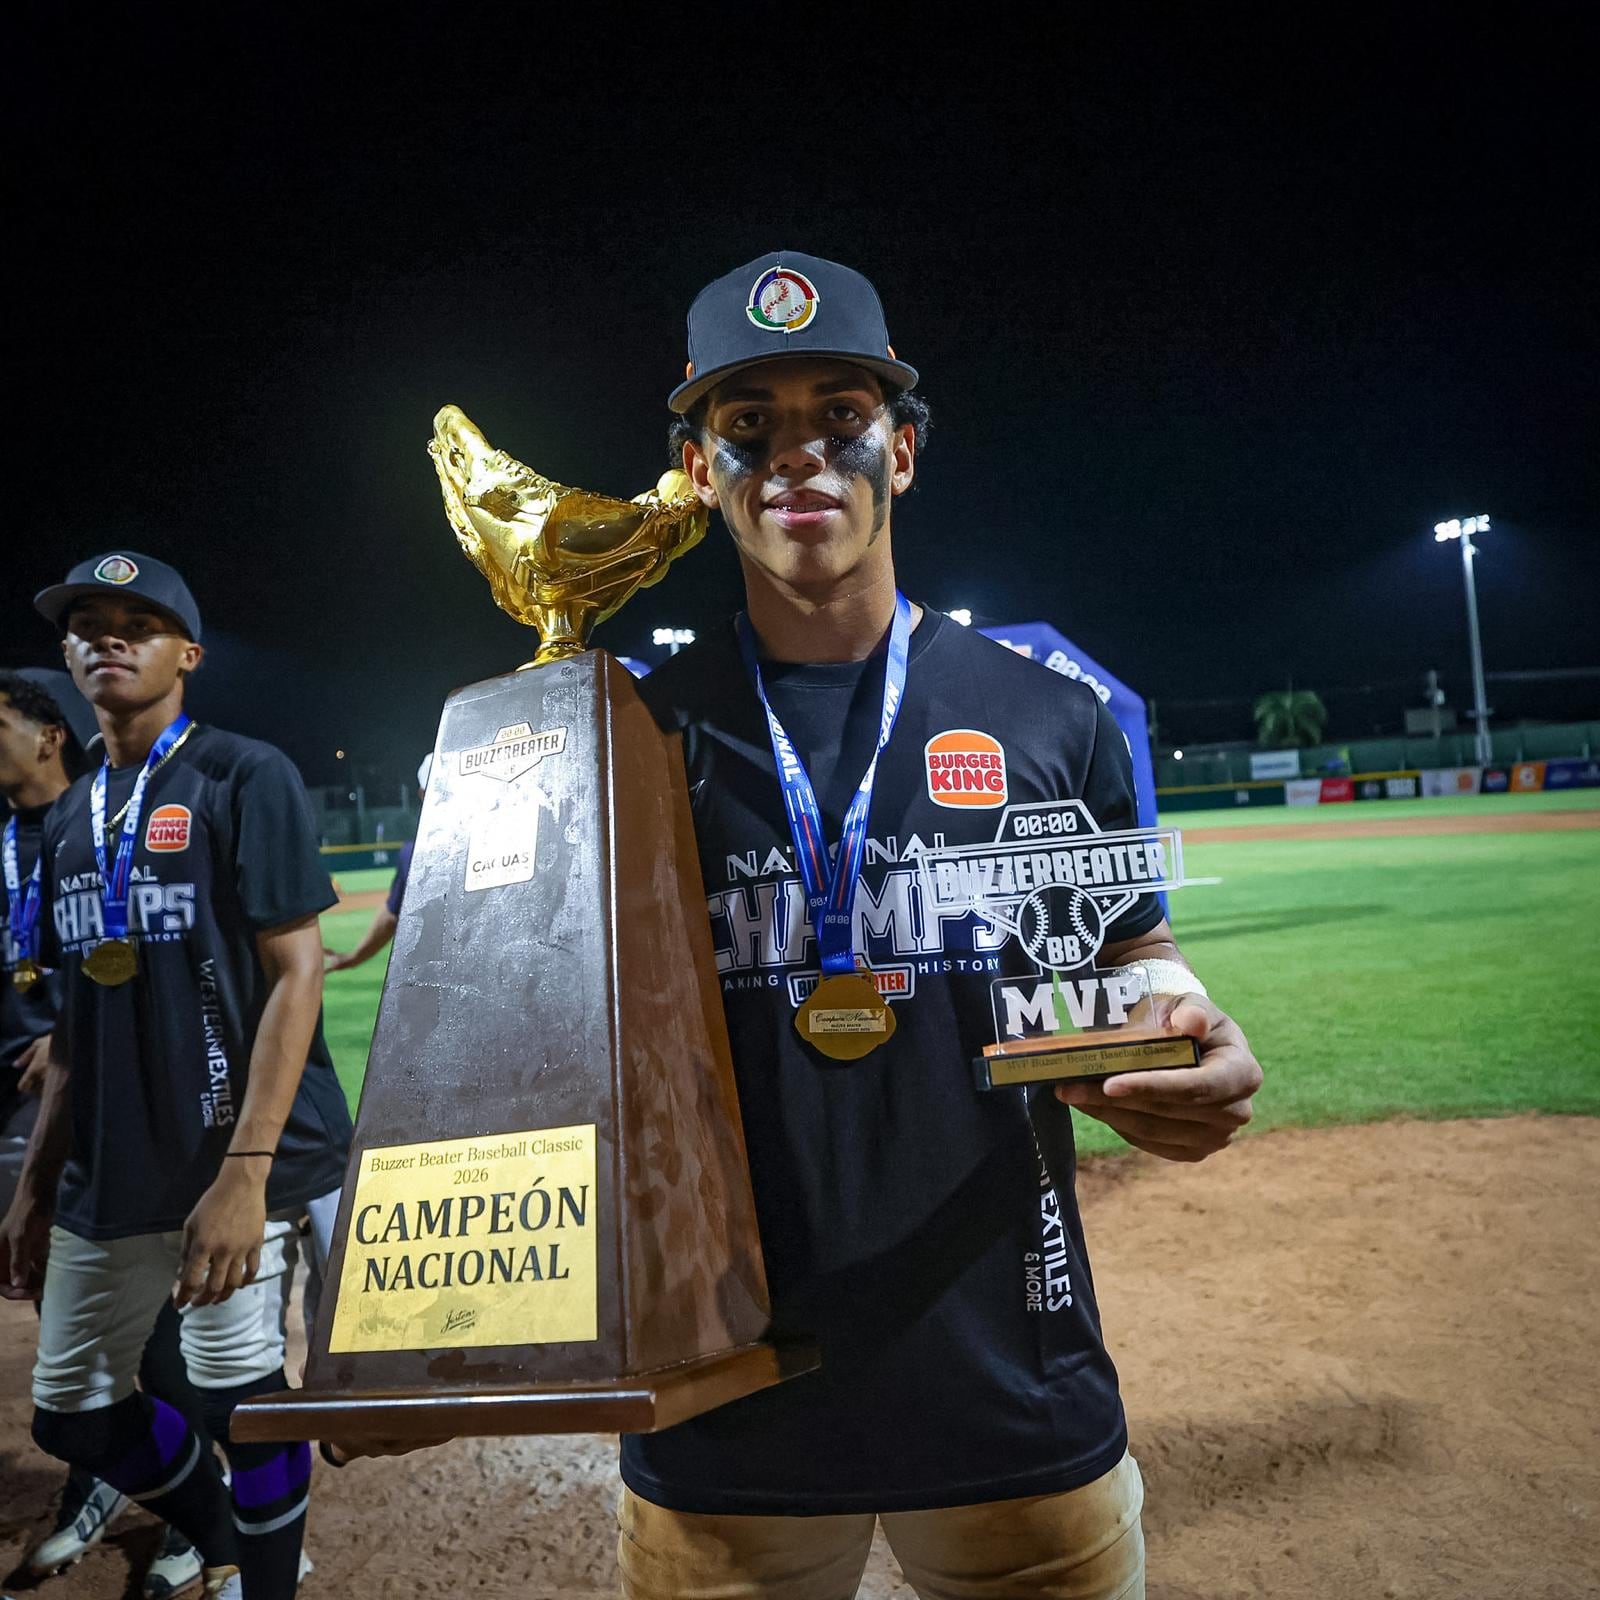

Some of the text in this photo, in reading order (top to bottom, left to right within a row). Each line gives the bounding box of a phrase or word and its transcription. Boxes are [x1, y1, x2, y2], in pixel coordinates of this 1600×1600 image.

[928, 754, 1003, 769] BURGER
[930, 769, 1004, 791] KING
[149, 829, 187, 841] KING
[151, 820, 188, 828] BURGER
[1013, 811, 1078, 837] 00:00
[60, 865, 158, 893] NATIAL
[935, 842, 1169, 900] BUZZERBEATER
[53, 882, 196, 943] HAPS
[1046, 934, 1081, 964] BB
[723, 974, 780, 992] AKING
[917, 956, 999, 975] HISTORY
[1001, 975, 1142, 1035] MVP
[1006, 1060, 1028, 1070] MVP
[1031, 1056, 1063, 1068] Buzzer
[1067, 1053, 1098, 1064] Beater
[1101, 1048, 1141, 1060] Baseball
[371, 1136, 583, 1172] Buzzer Beater Baseball Classic
[453, 1168, 489, 1185] 2026
[355, 1176, 589, 1245] CAMPEÓN
[362, 1243, 570, 1293] NACIONAL
[1025, 1266, 1043, 1312] MORE
